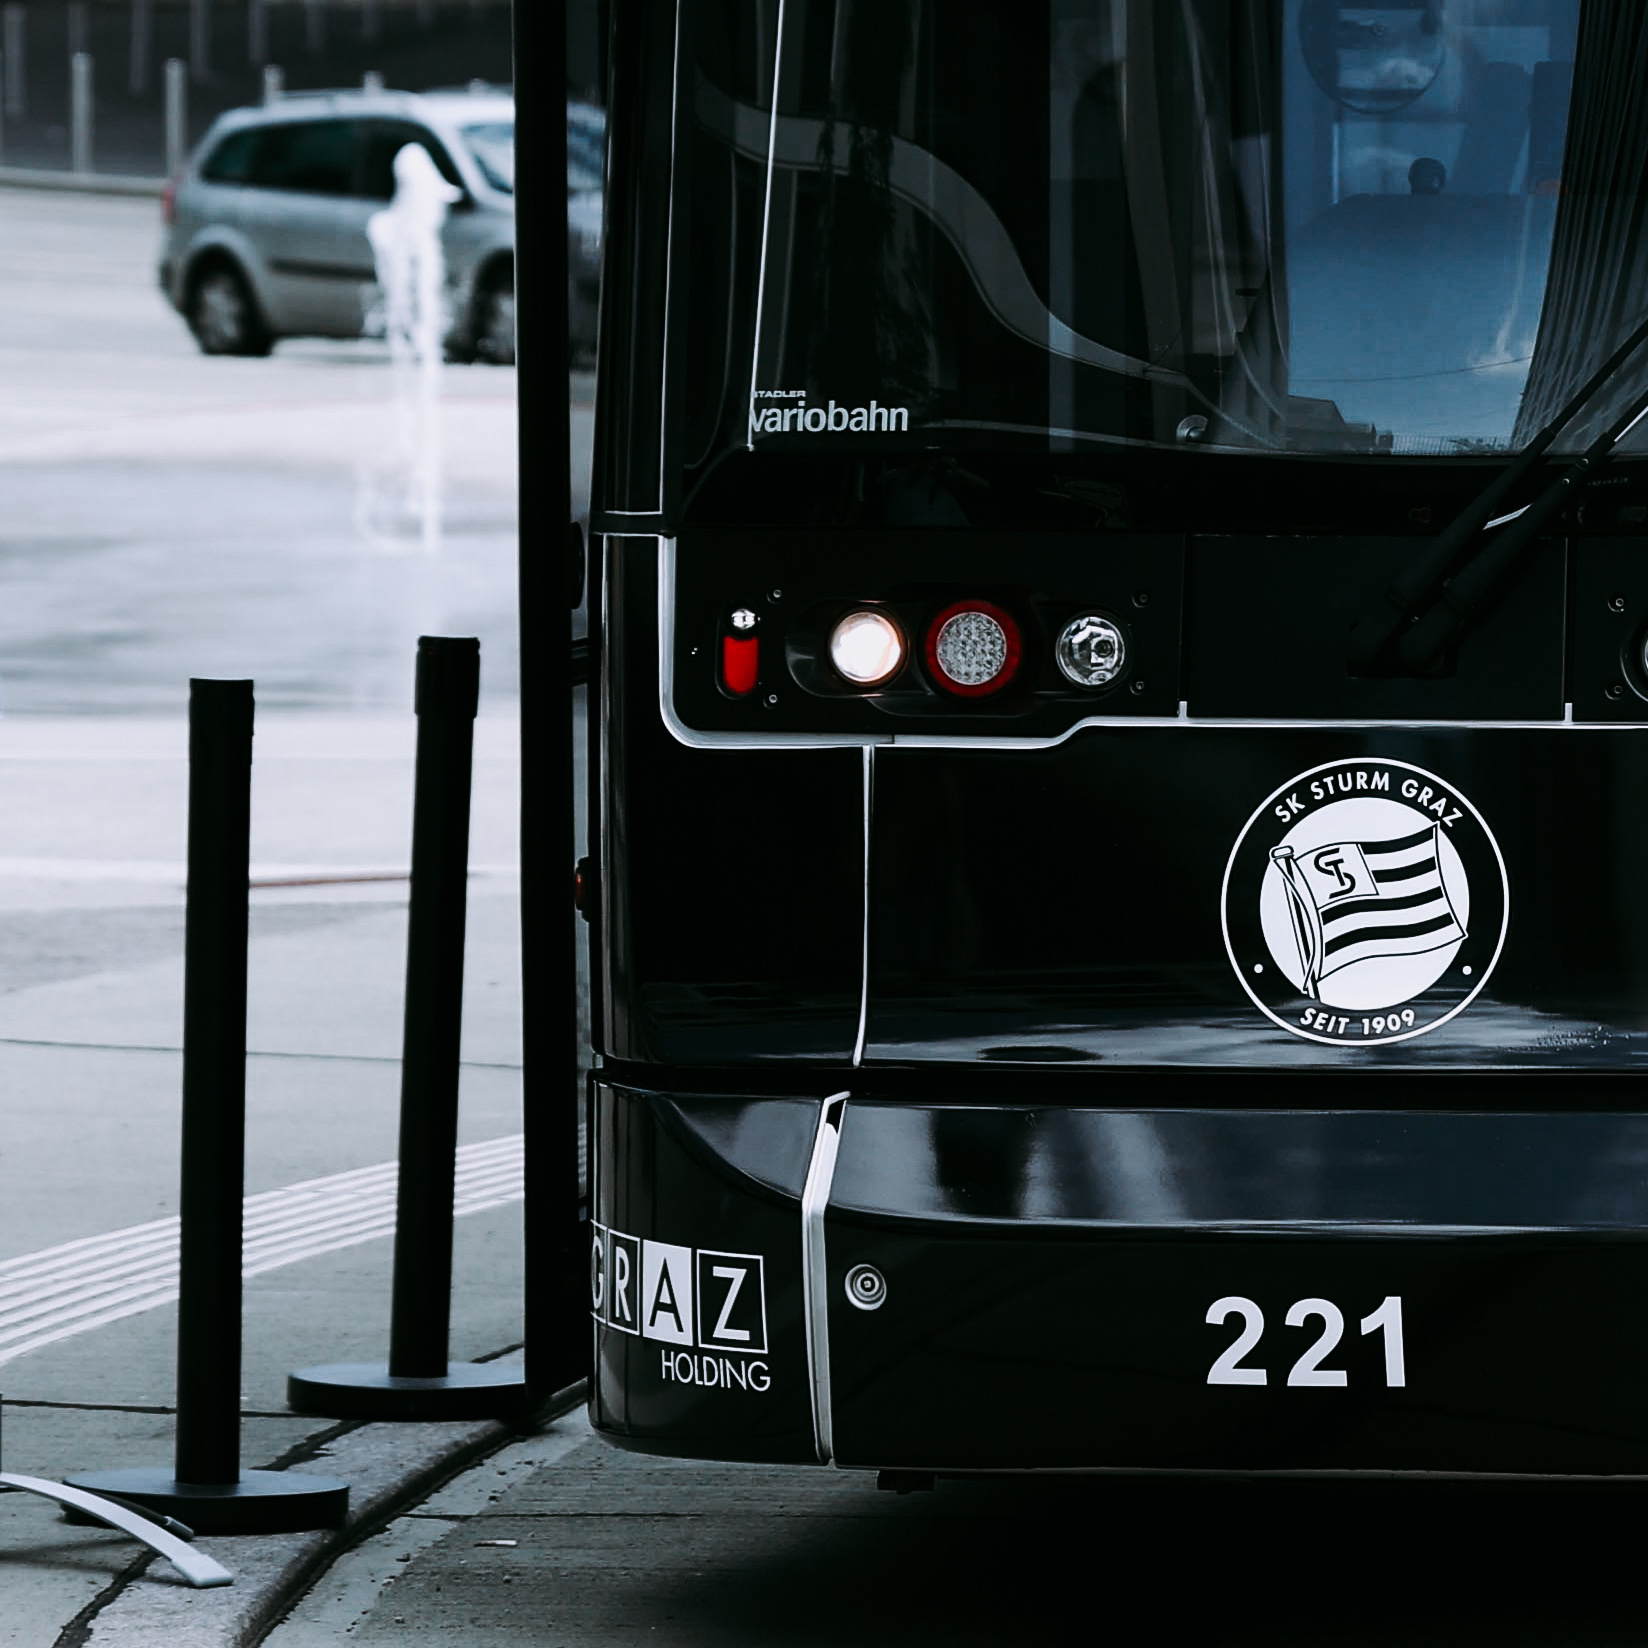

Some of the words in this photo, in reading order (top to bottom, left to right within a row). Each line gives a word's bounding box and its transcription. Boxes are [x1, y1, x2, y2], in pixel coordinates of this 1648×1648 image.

[750, 400, 909, 432] variobahn
[1274, 792, 1306, 824] SK
[1309, 770, 1390, 801] STURM
[1400, 778, 1464, 828] GRAZ
[1299, 1007, 1351, 1035] SEIT
[1360, 1008, 1416, 1036] 1909
[590, 1234, 752, 1342] GRAZ
[1203, 1294, 1408, 1388] 221
[660, 1348, 772, 1393] HOLDING
